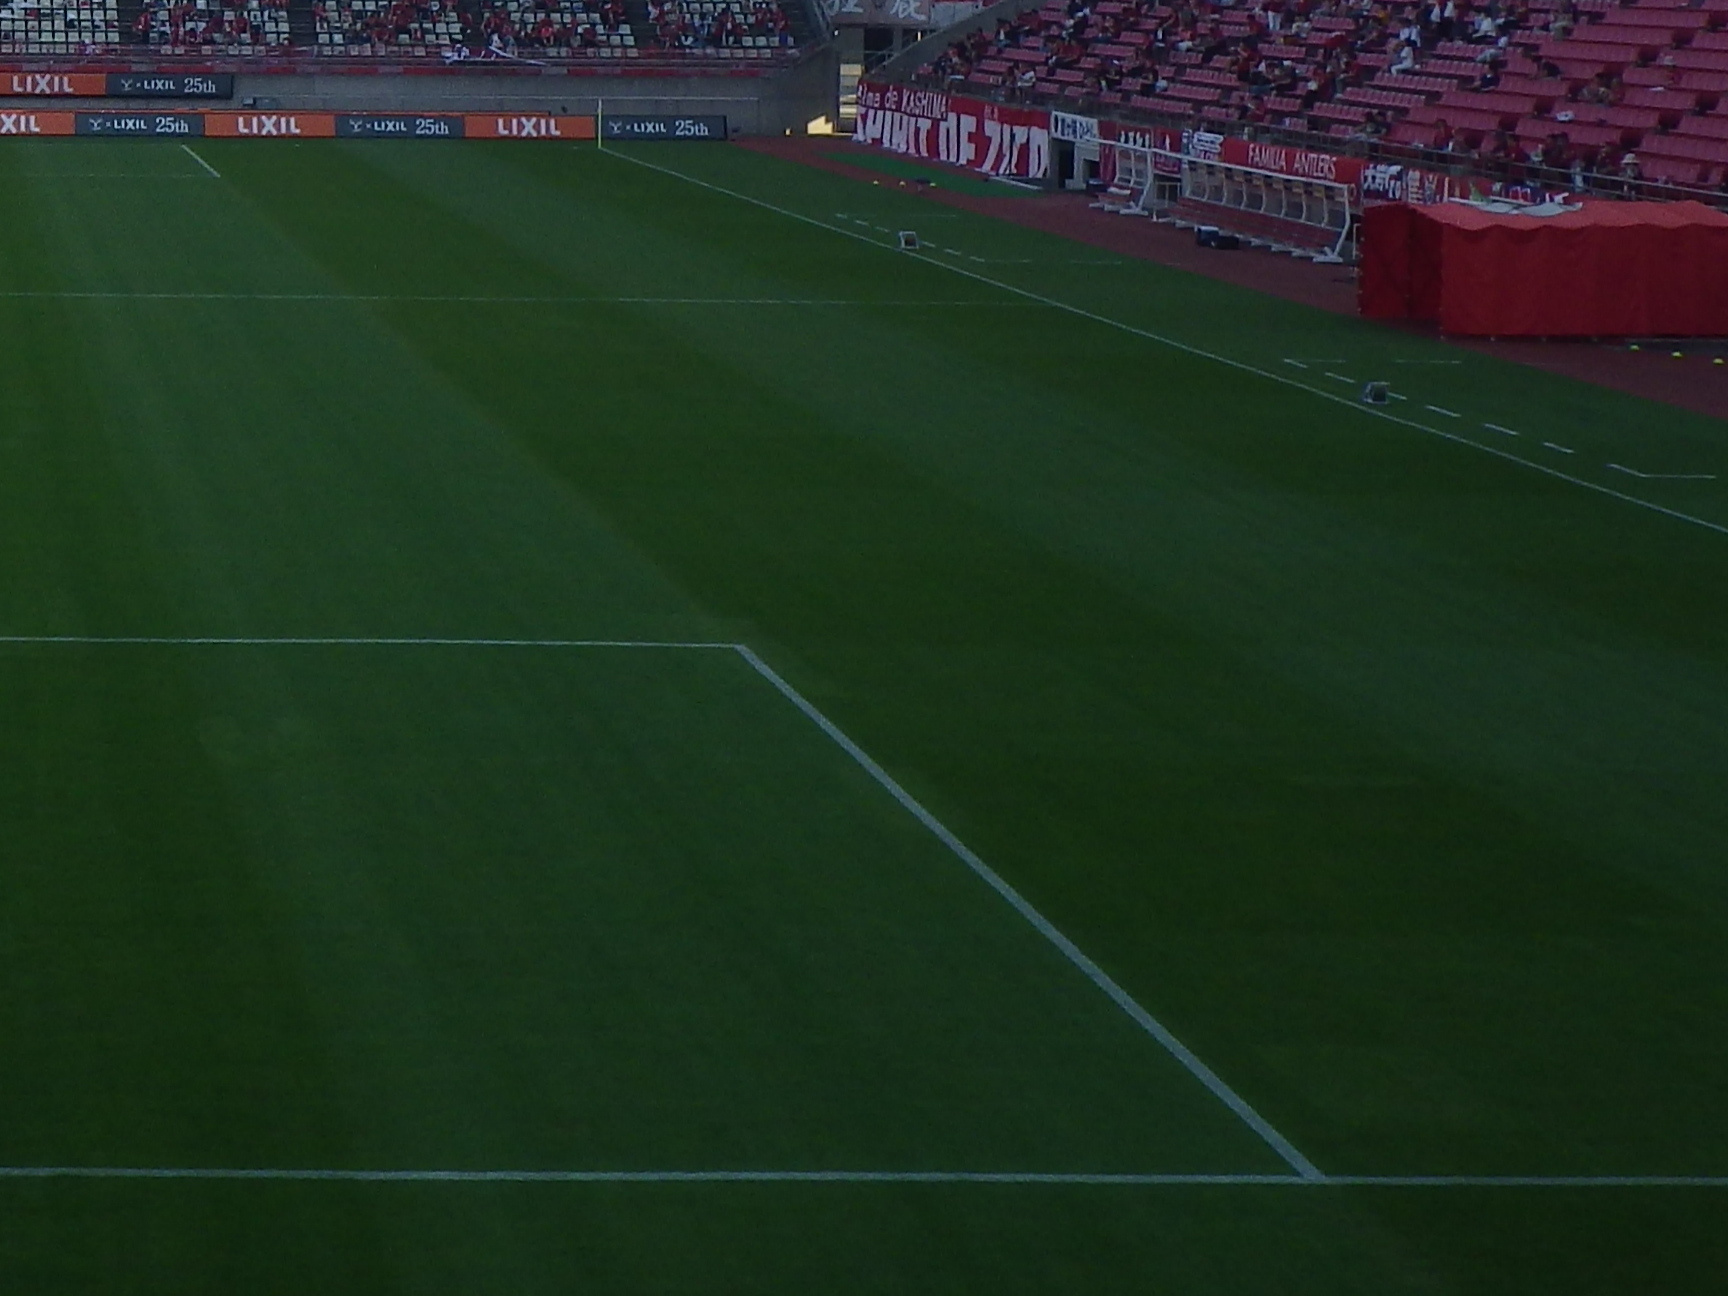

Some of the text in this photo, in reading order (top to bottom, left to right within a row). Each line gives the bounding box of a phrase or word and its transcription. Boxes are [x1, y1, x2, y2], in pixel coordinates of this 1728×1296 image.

[12, 74, 74, 94] LIXIL
[144, 78, 216, 94] LIXIL 25th
[884, 86, 898, 110] de
[114, 117, 188, 133] LIXIL 25th
[237, 116, 301, 136] LIXIL
[374, 118, 448, 134] LIXIL 25th
[497, 116, 561, 138] LIXIL
[634, 120, 708, 136] LIXIL 25th
[938, 112, 977, 166] OF
[1248, 143, 1337, 180] FAMILIA ANTLERS
